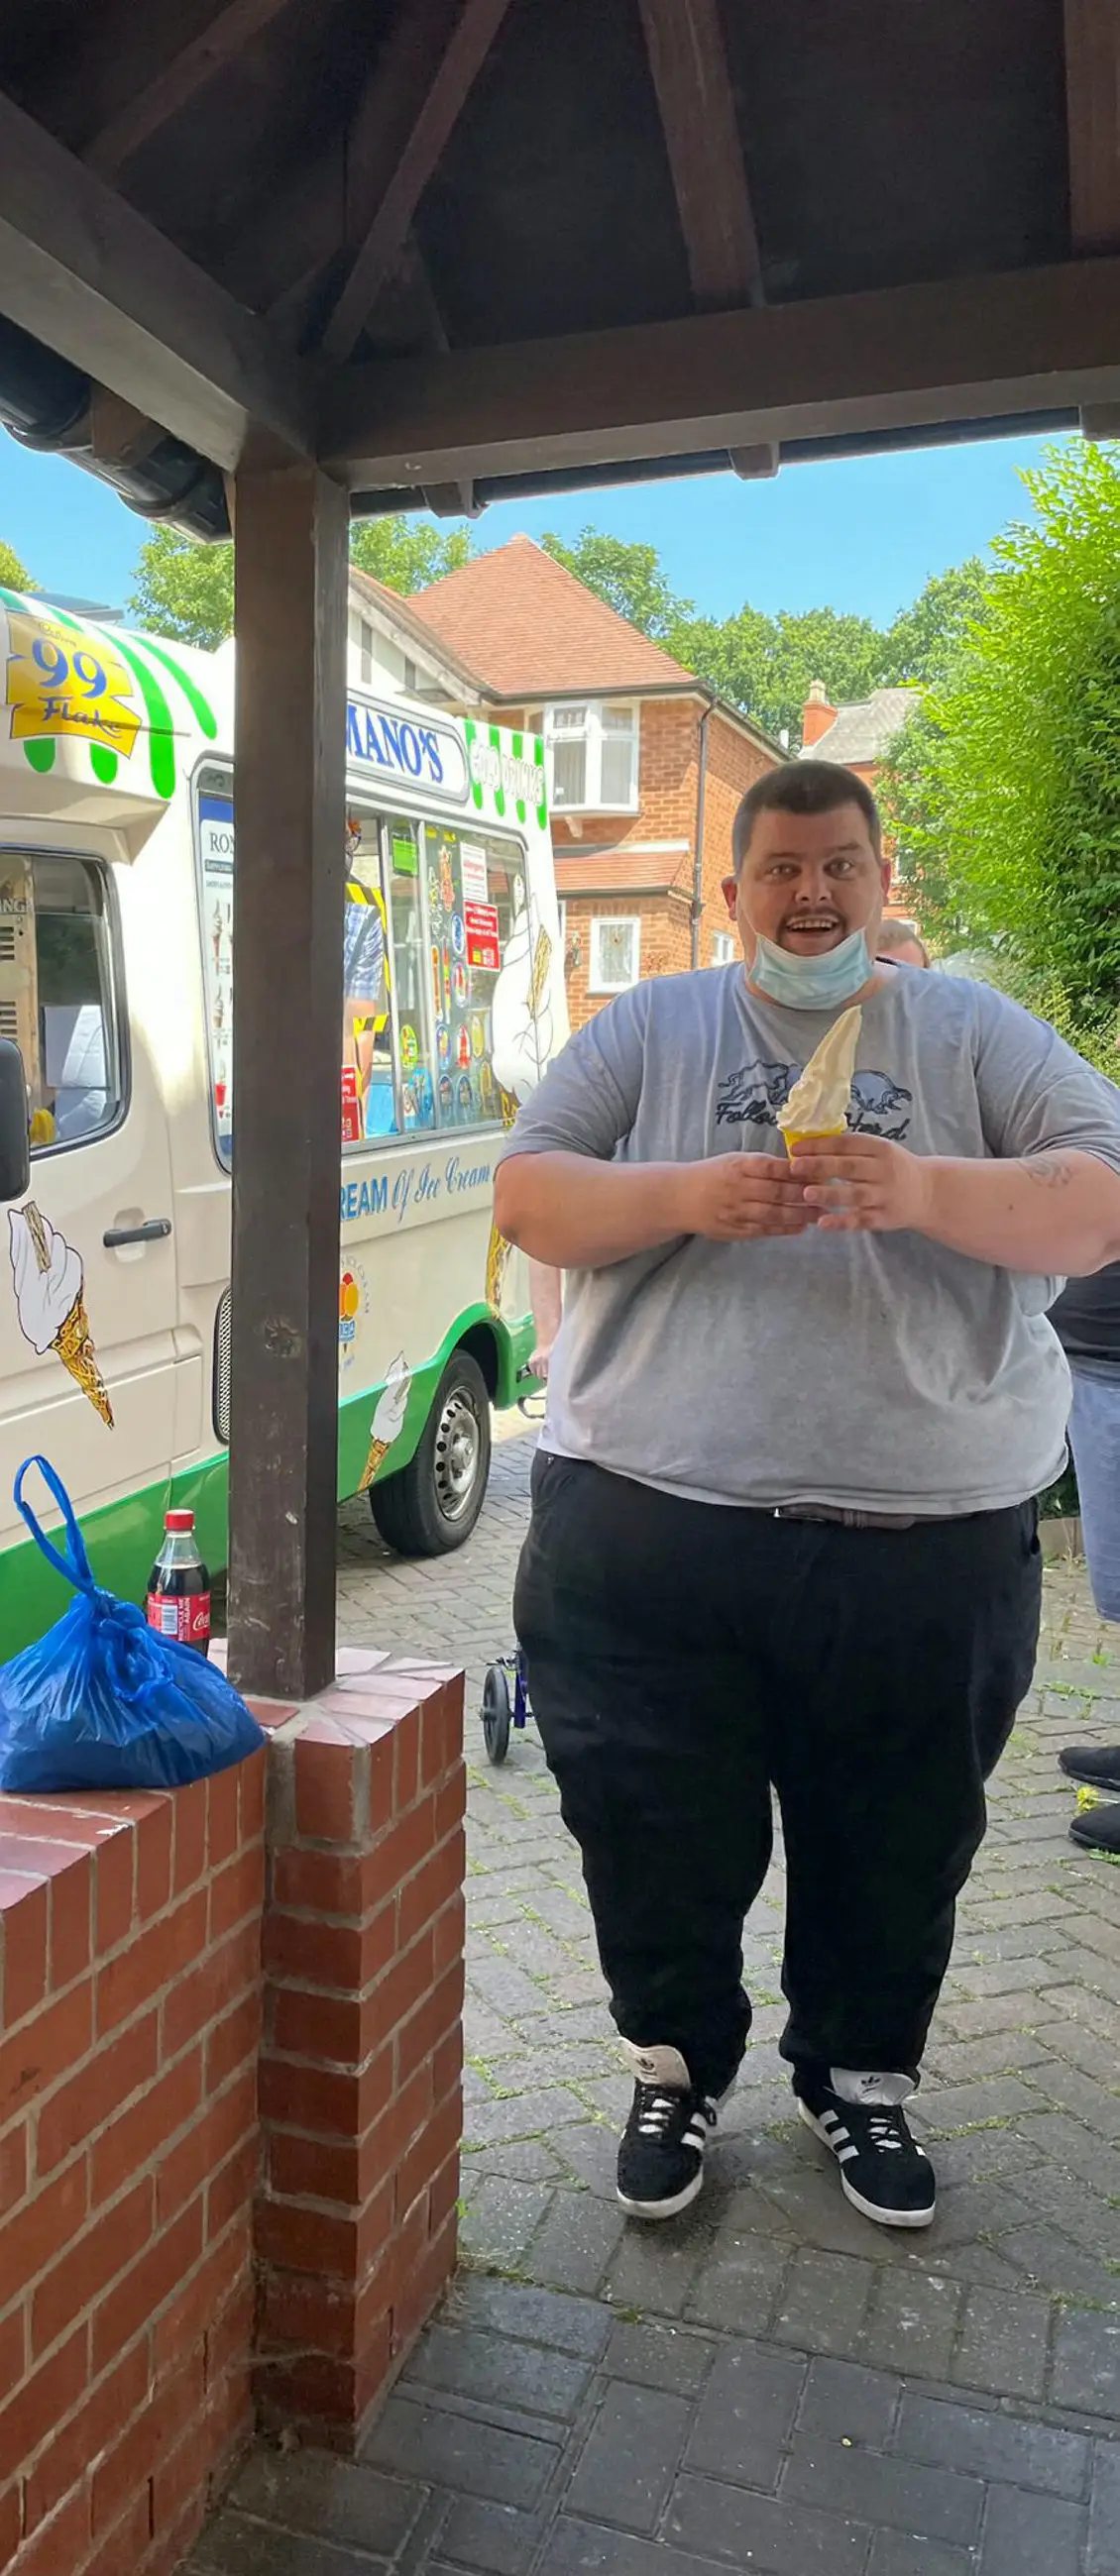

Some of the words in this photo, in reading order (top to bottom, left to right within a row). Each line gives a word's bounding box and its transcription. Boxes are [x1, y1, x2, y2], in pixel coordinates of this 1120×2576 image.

[32, 638, 108, 698] 99
[37, 696, 124, 739] Flake
[392, 1168, 415, 1225] Of
[414, 1163, 442, 1203] Ice
[445, 1156, 491, 1194] Cream
